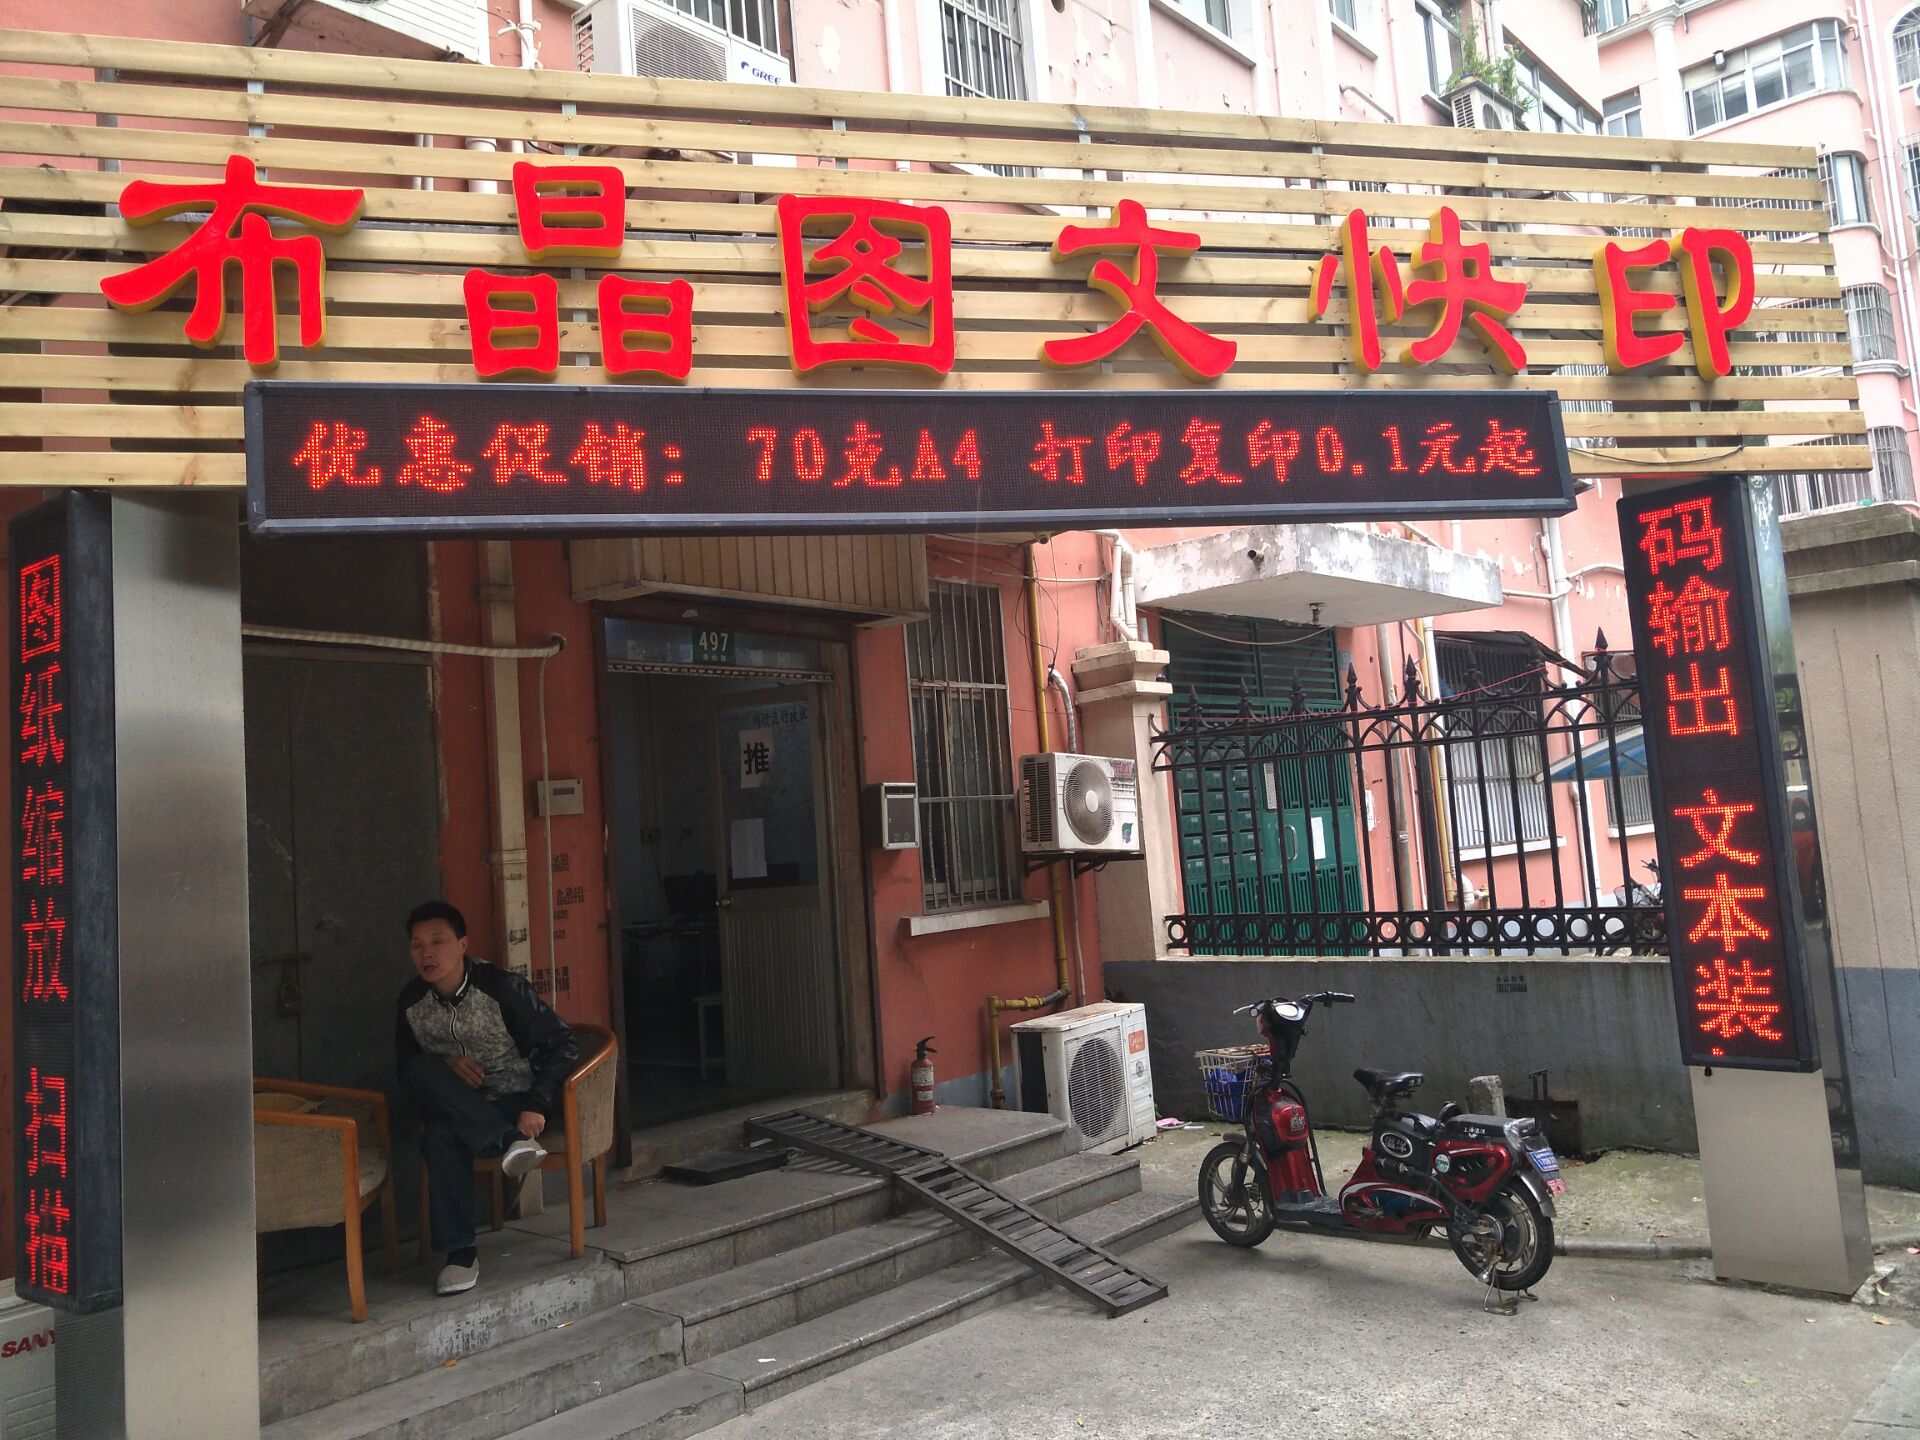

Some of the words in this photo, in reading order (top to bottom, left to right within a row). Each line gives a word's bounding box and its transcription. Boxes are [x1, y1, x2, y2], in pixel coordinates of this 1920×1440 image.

[751, 67, 782, 86] GREE
[98, 154, 1756, 383] 布晶图文快印
[698, 631, 729, 652] 497
[1637, 496, 1741, 737] 码输出
[743, 741, 770, 776] 推
[1673, 788, 1783, 1056] 文本装
